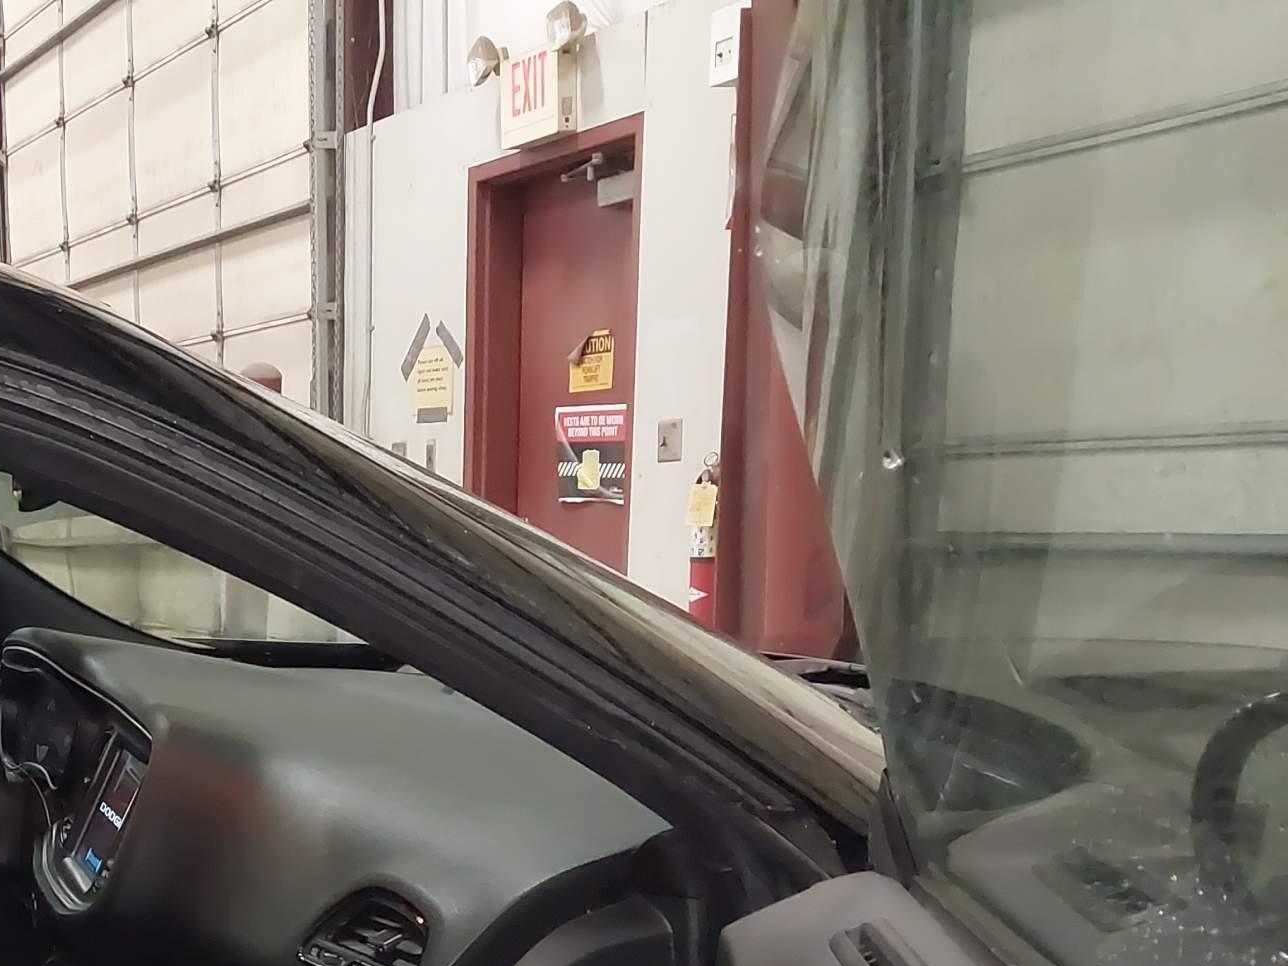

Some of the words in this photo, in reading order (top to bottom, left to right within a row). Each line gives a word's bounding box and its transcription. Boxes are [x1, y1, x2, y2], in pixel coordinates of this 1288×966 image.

[511, 51, 547, 117] EXIT
[585, 336, 612, 353] UTION
[563, 416, 580, 427] VESTS
[580, 415, 591, 426] ARE
[591, 415, 598, 426] TO
[598, 415, 606, 426] BE
[567, 427, 589, 437] BEYOND
[589, 426, 601, 437] THIS
[601, 426, 618, 437] POINT
